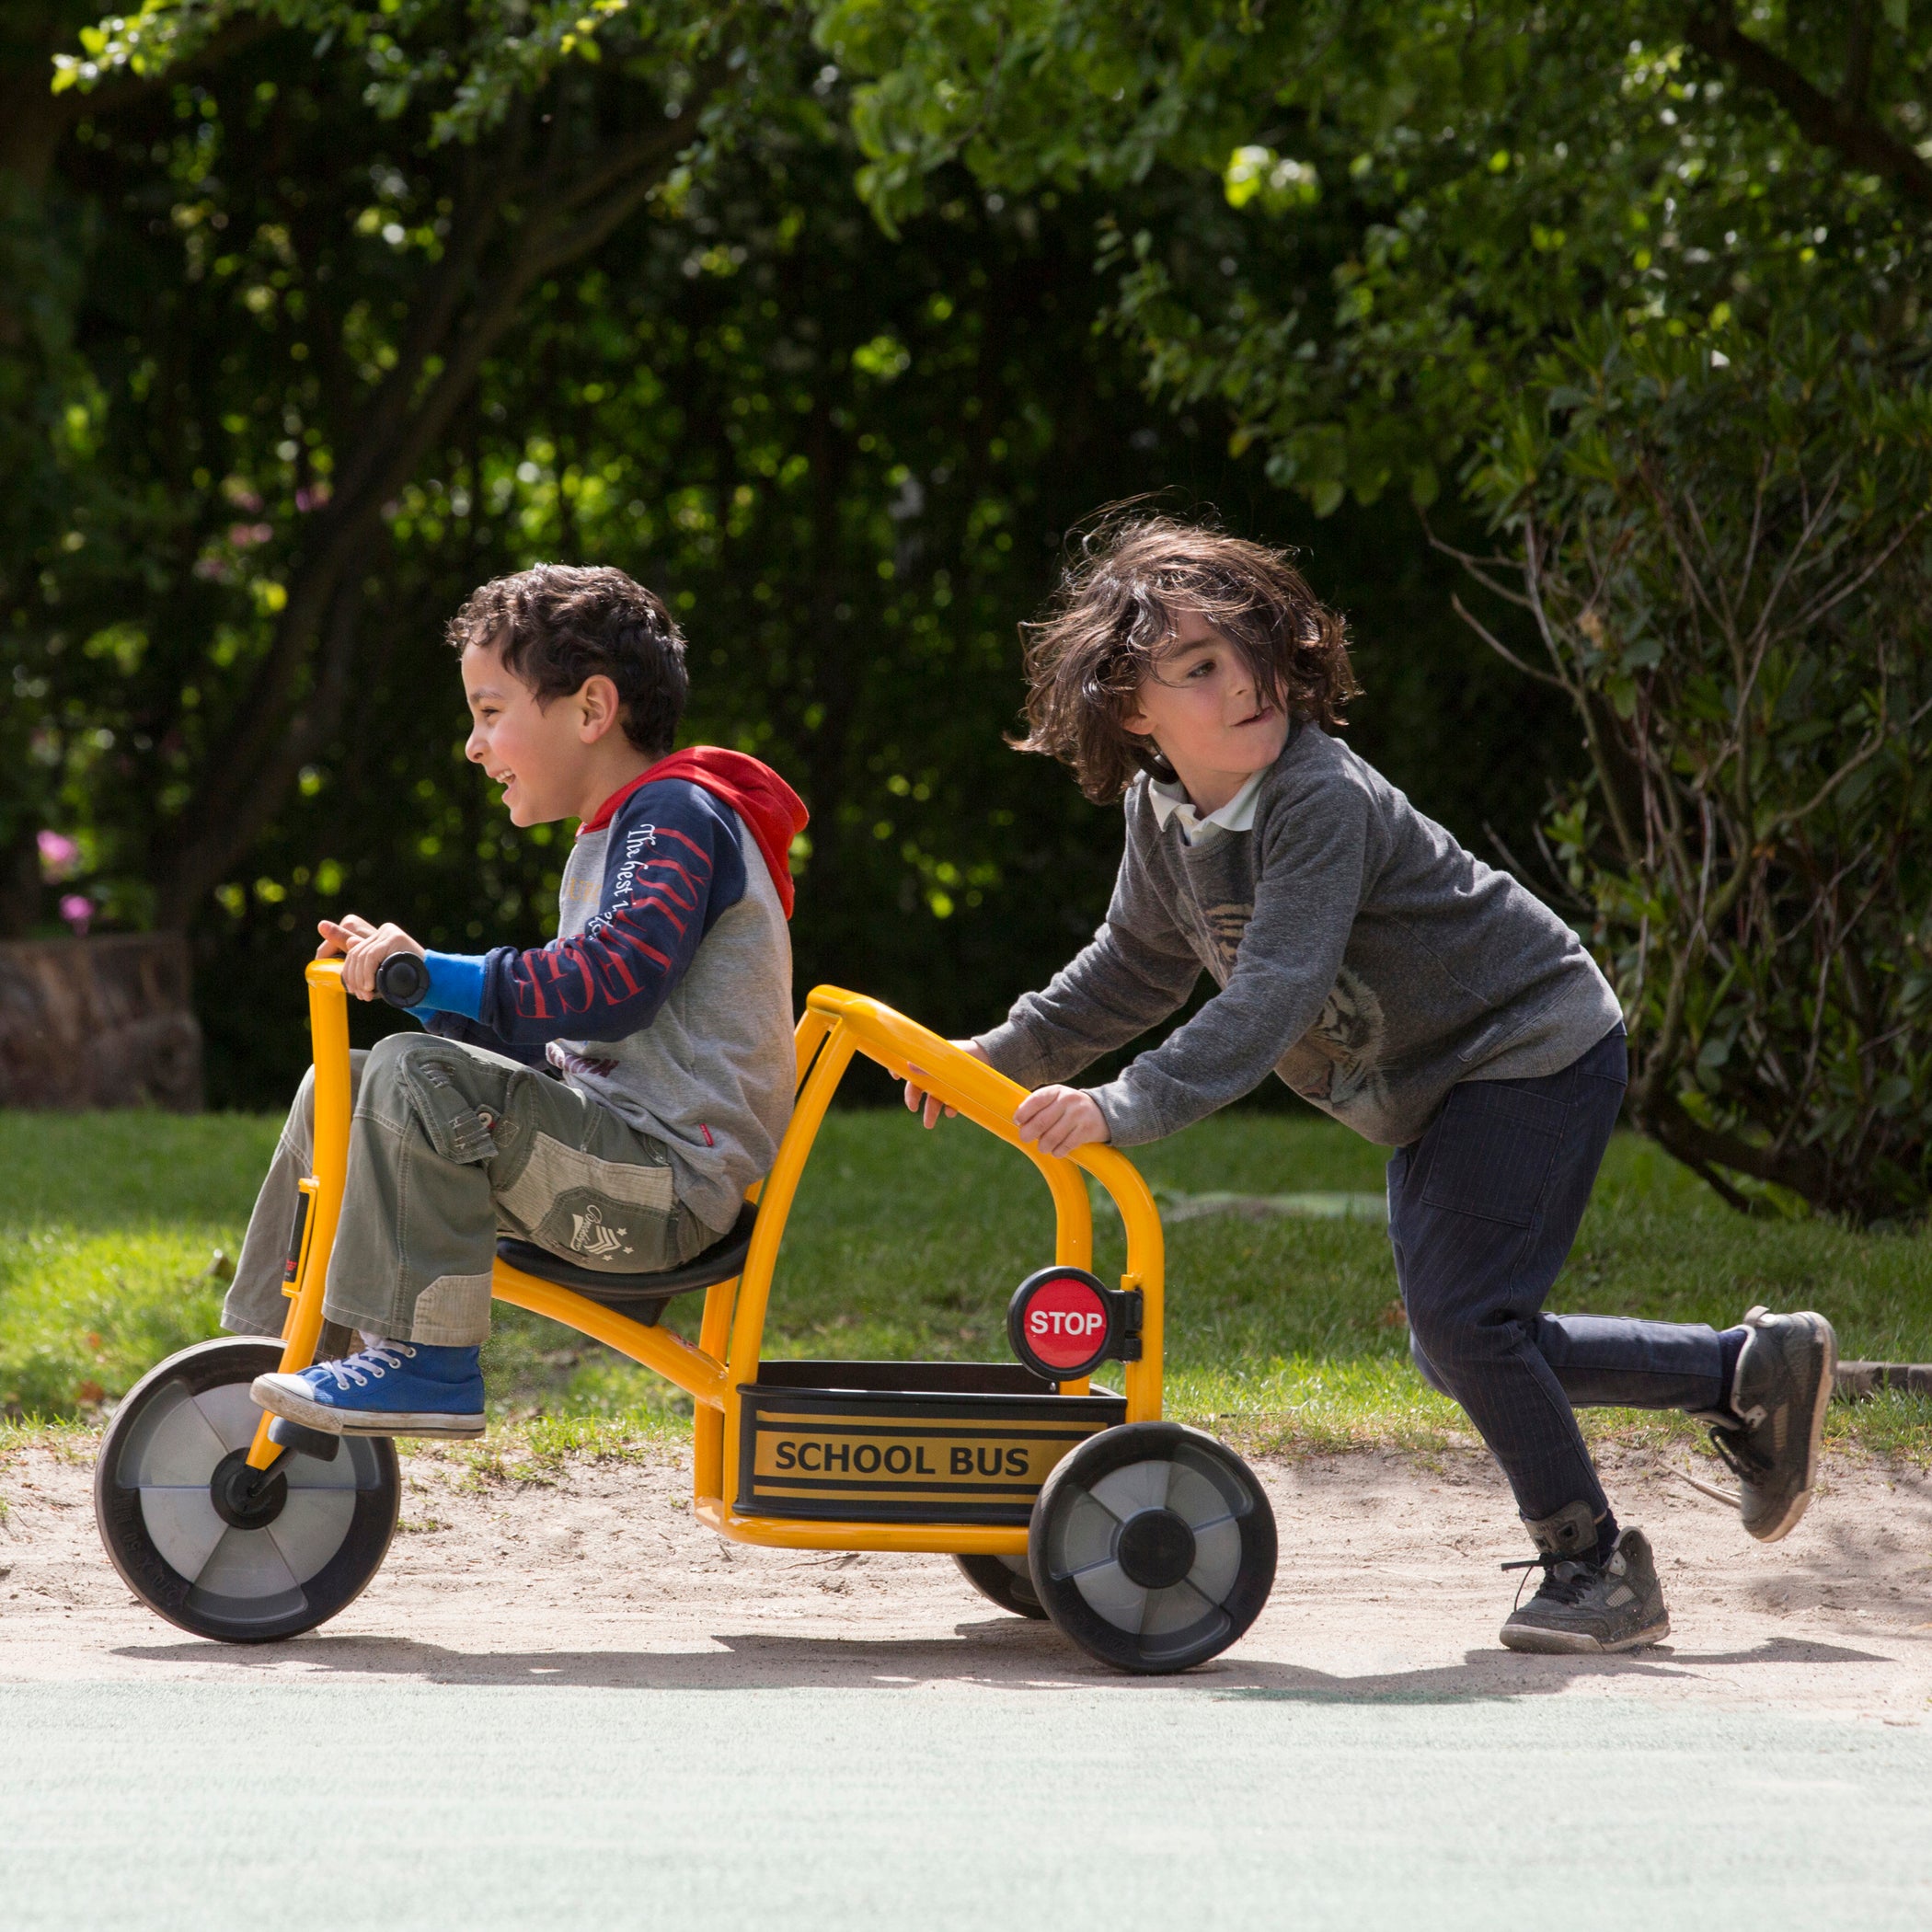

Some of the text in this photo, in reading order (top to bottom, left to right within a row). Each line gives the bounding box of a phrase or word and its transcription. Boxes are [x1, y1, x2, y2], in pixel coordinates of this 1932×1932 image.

[627, 823, 656, 858] The
[1030, 1310, 1102, 1335] STOP
[776, 1442, 1029, 1476] SCHOOL BUS
